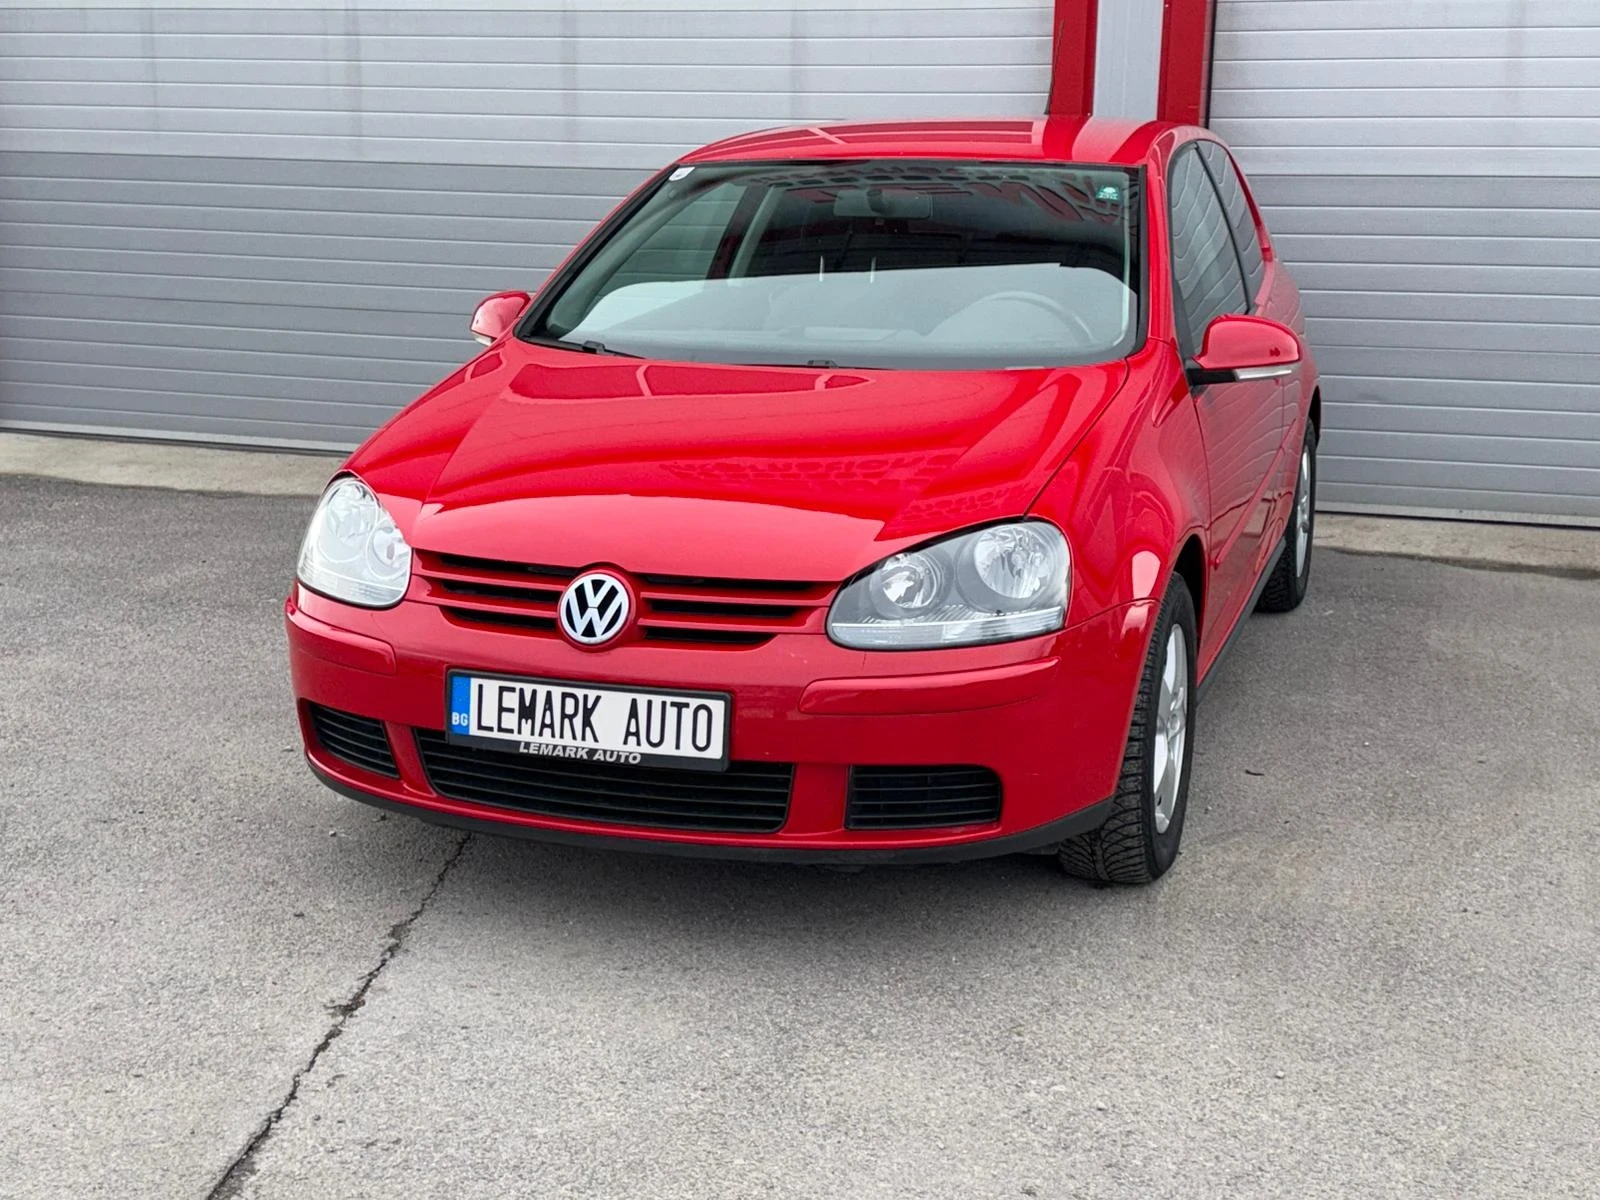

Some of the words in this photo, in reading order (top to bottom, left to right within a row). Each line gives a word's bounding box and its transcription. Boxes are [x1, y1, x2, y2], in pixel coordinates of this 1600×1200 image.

[560, 573, 630, 644] VW
[452, 712, 468, 726] BG
[477, 684, 602, 743] LEMARK
[623, 698, 713, 752] AUTO
[519, 741, 589, 760] LEMARK
[593, 750, 641, 765] AUTO
